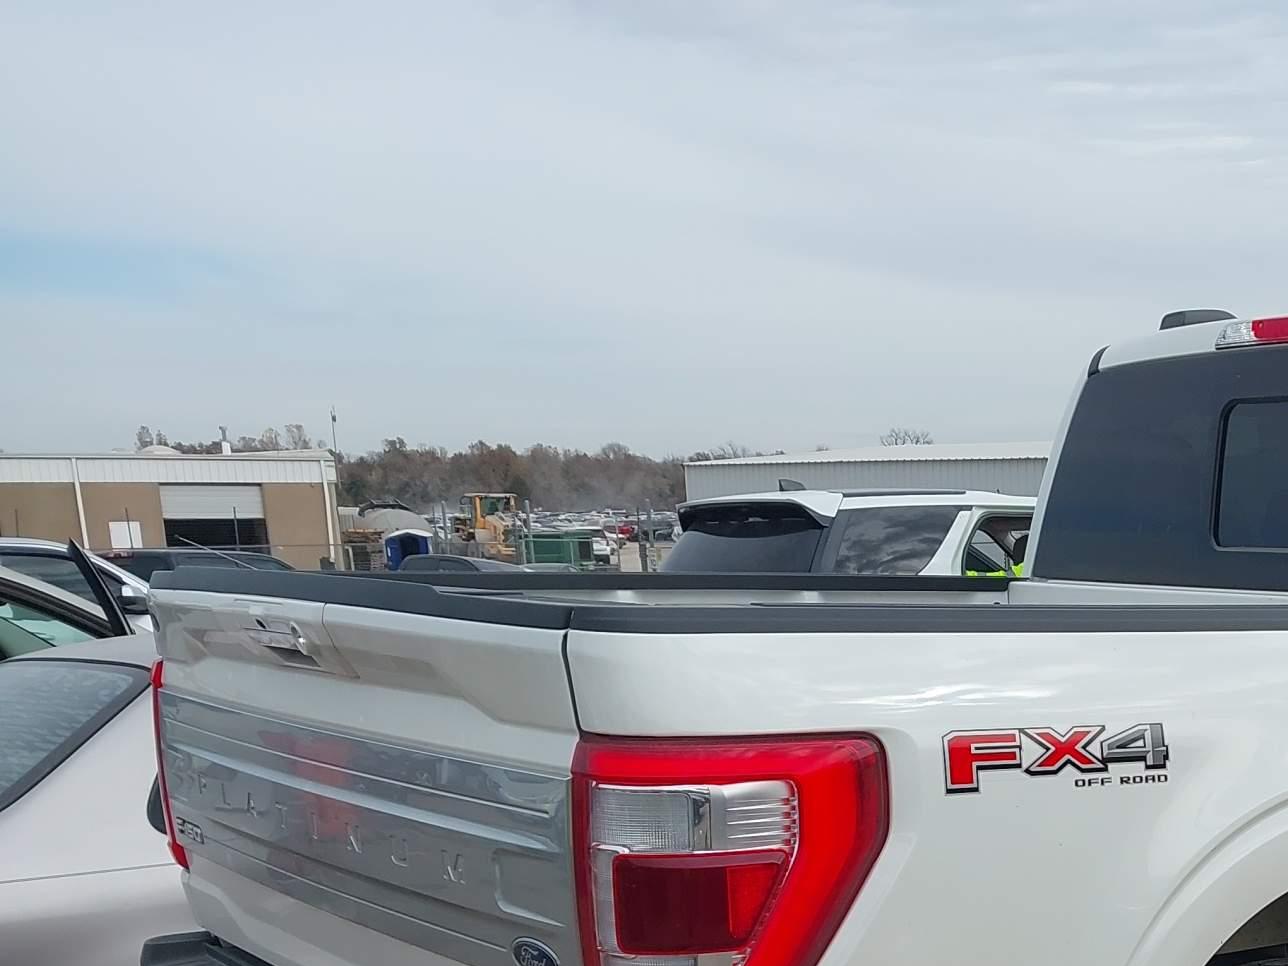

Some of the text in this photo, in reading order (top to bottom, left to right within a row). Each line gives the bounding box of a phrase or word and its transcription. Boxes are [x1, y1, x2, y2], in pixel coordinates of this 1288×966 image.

[942, 723, 1169, 794] FX4
[1074, 774, 1168, 788] OFF ROAD
[198, 774, 466, 885] PLATINUM
